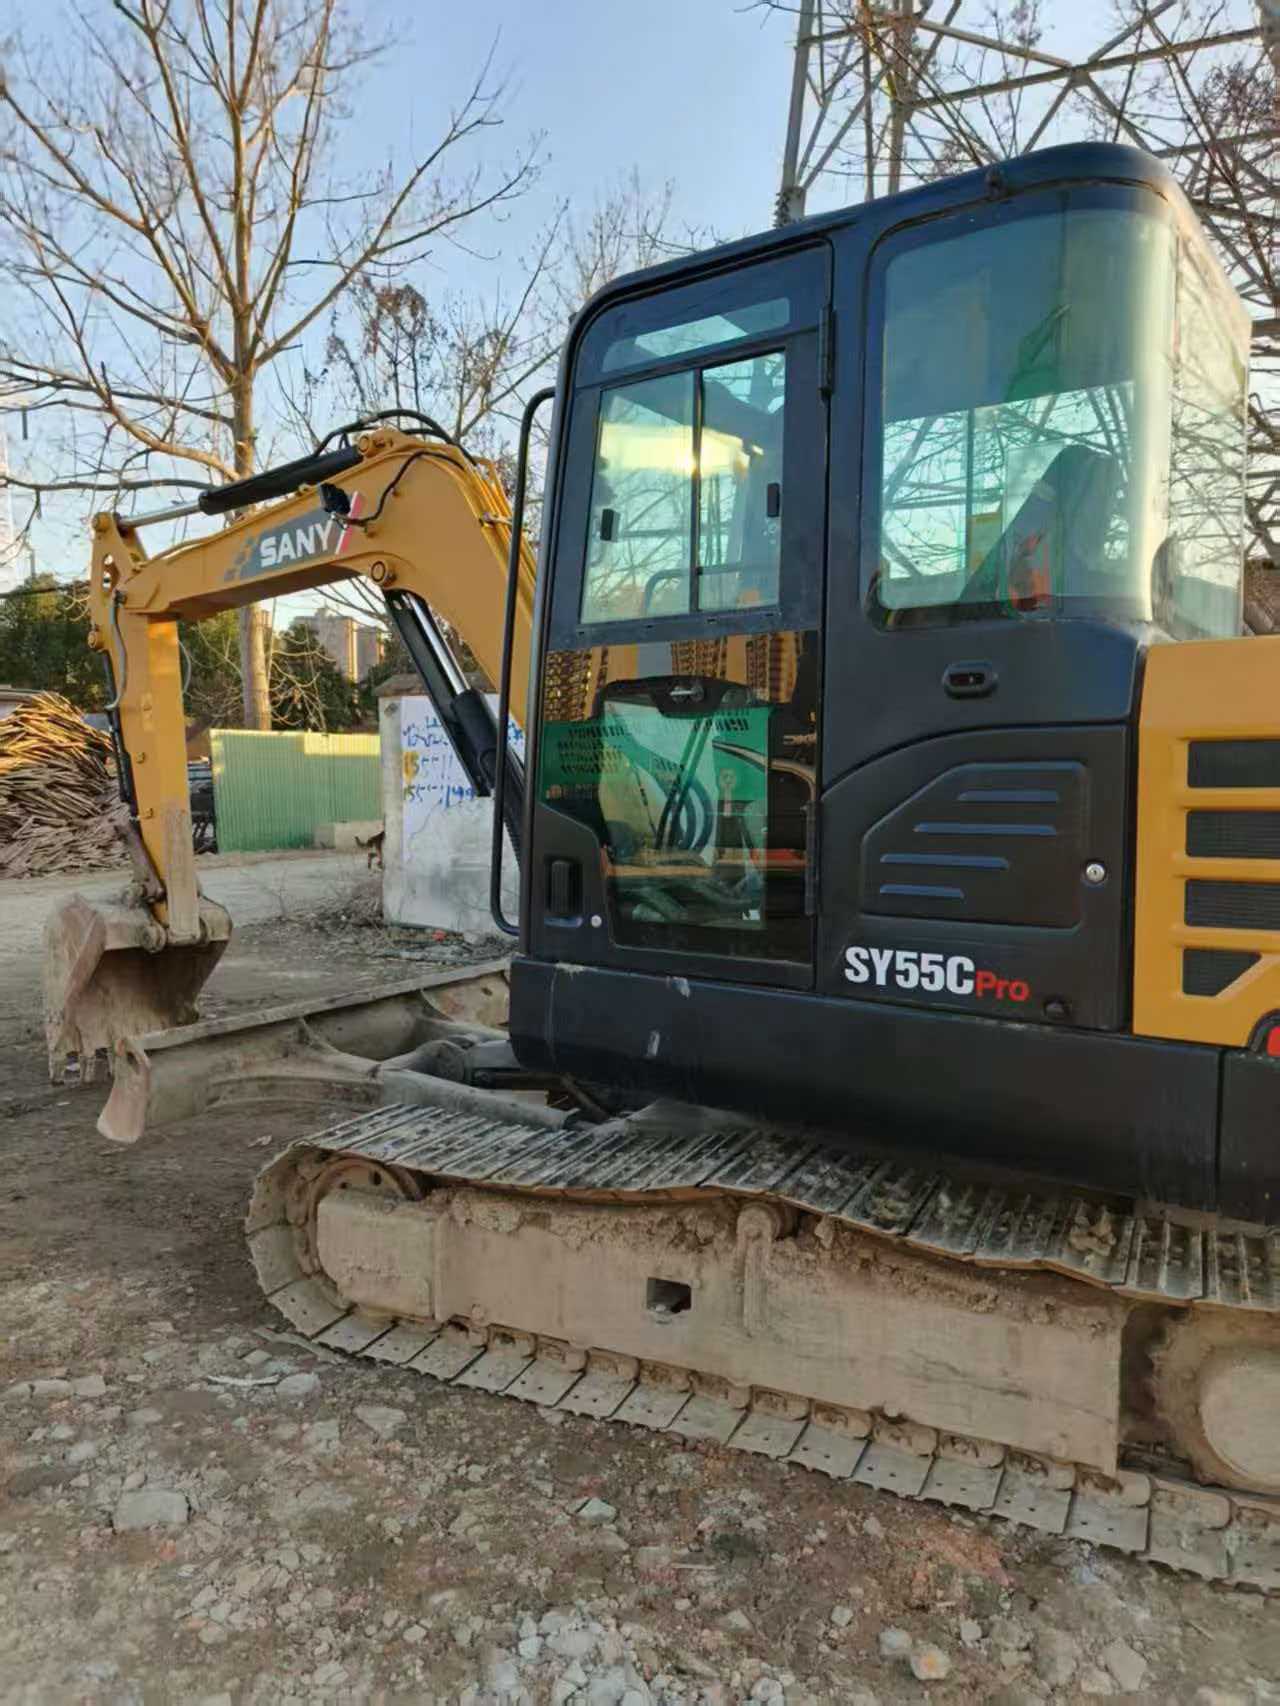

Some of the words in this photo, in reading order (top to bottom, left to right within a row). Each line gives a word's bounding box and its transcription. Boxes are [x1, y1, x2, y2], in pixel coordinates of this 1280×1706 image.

[260, 519, 333, 568] SANY
[844, 946, 975, 995] SY55C
[976, 970, 1030, 1002] Pro
